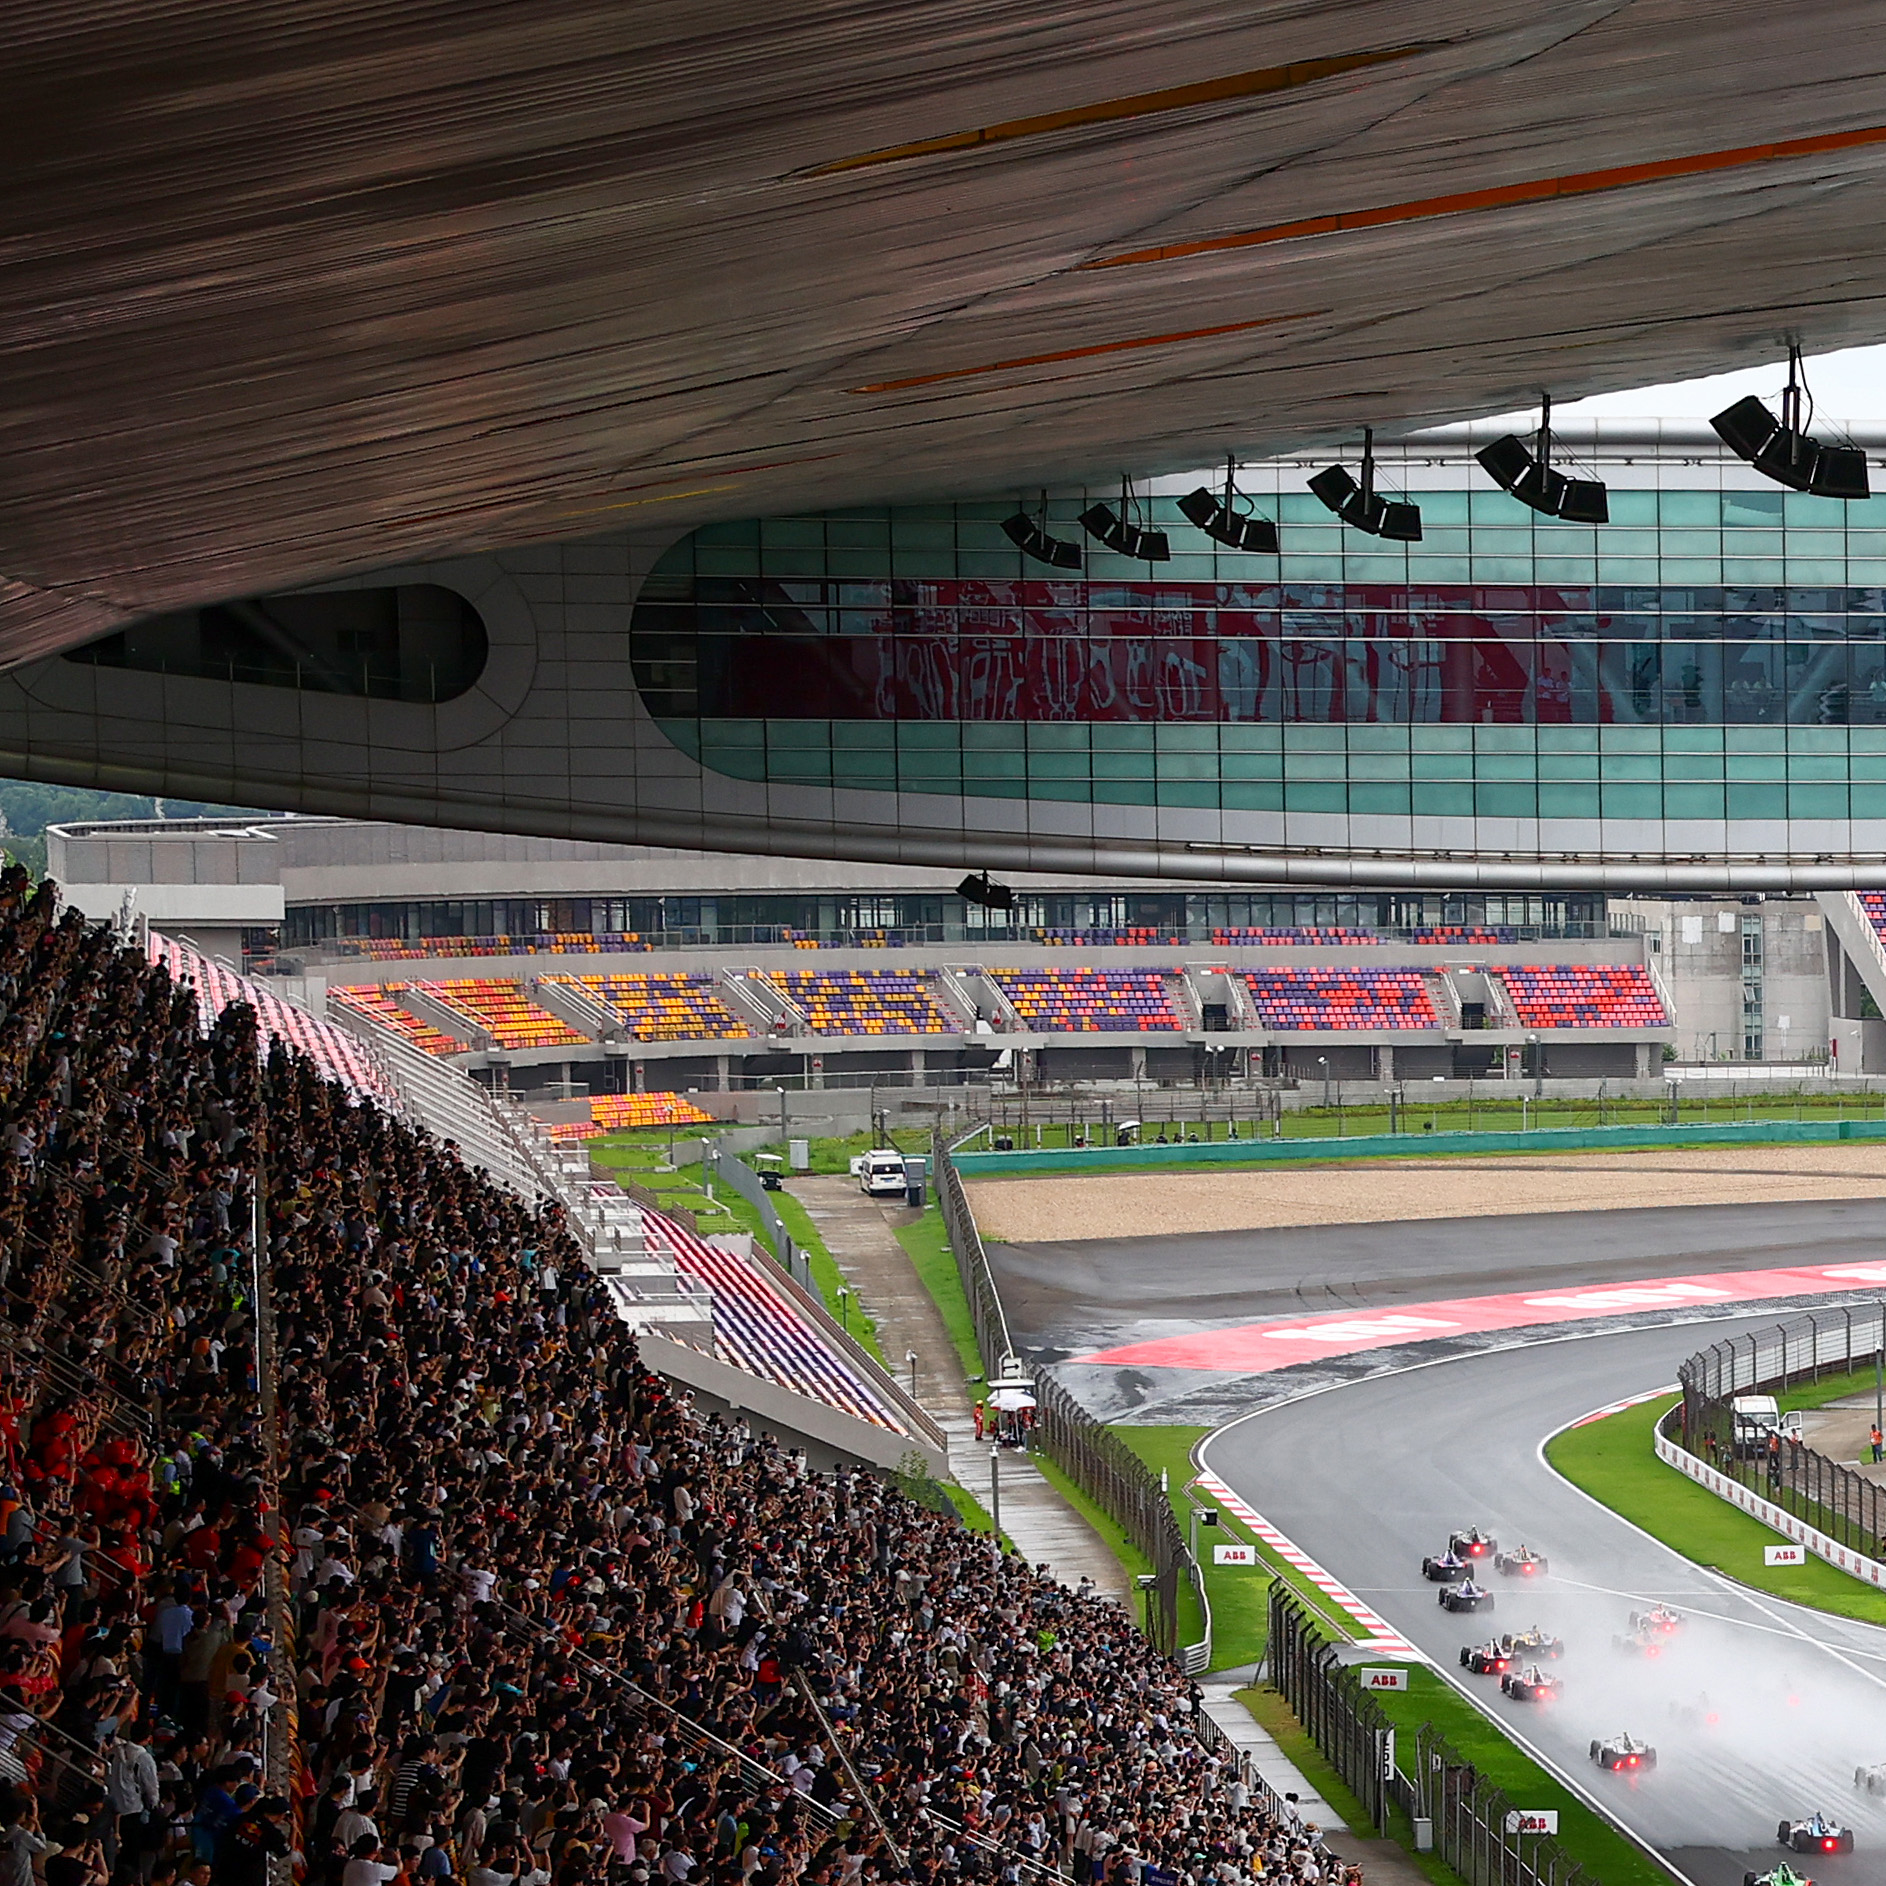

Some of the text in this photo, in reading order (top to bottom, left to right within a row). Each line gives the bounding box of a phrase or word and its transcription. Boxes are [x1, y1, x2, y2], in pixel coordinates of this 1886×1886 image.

[1222, 1549, 1247, 1562] ABB
[1774, 1551, 1796, 1561] ABB
[1371, 1675, 1398, 1687] ABB
